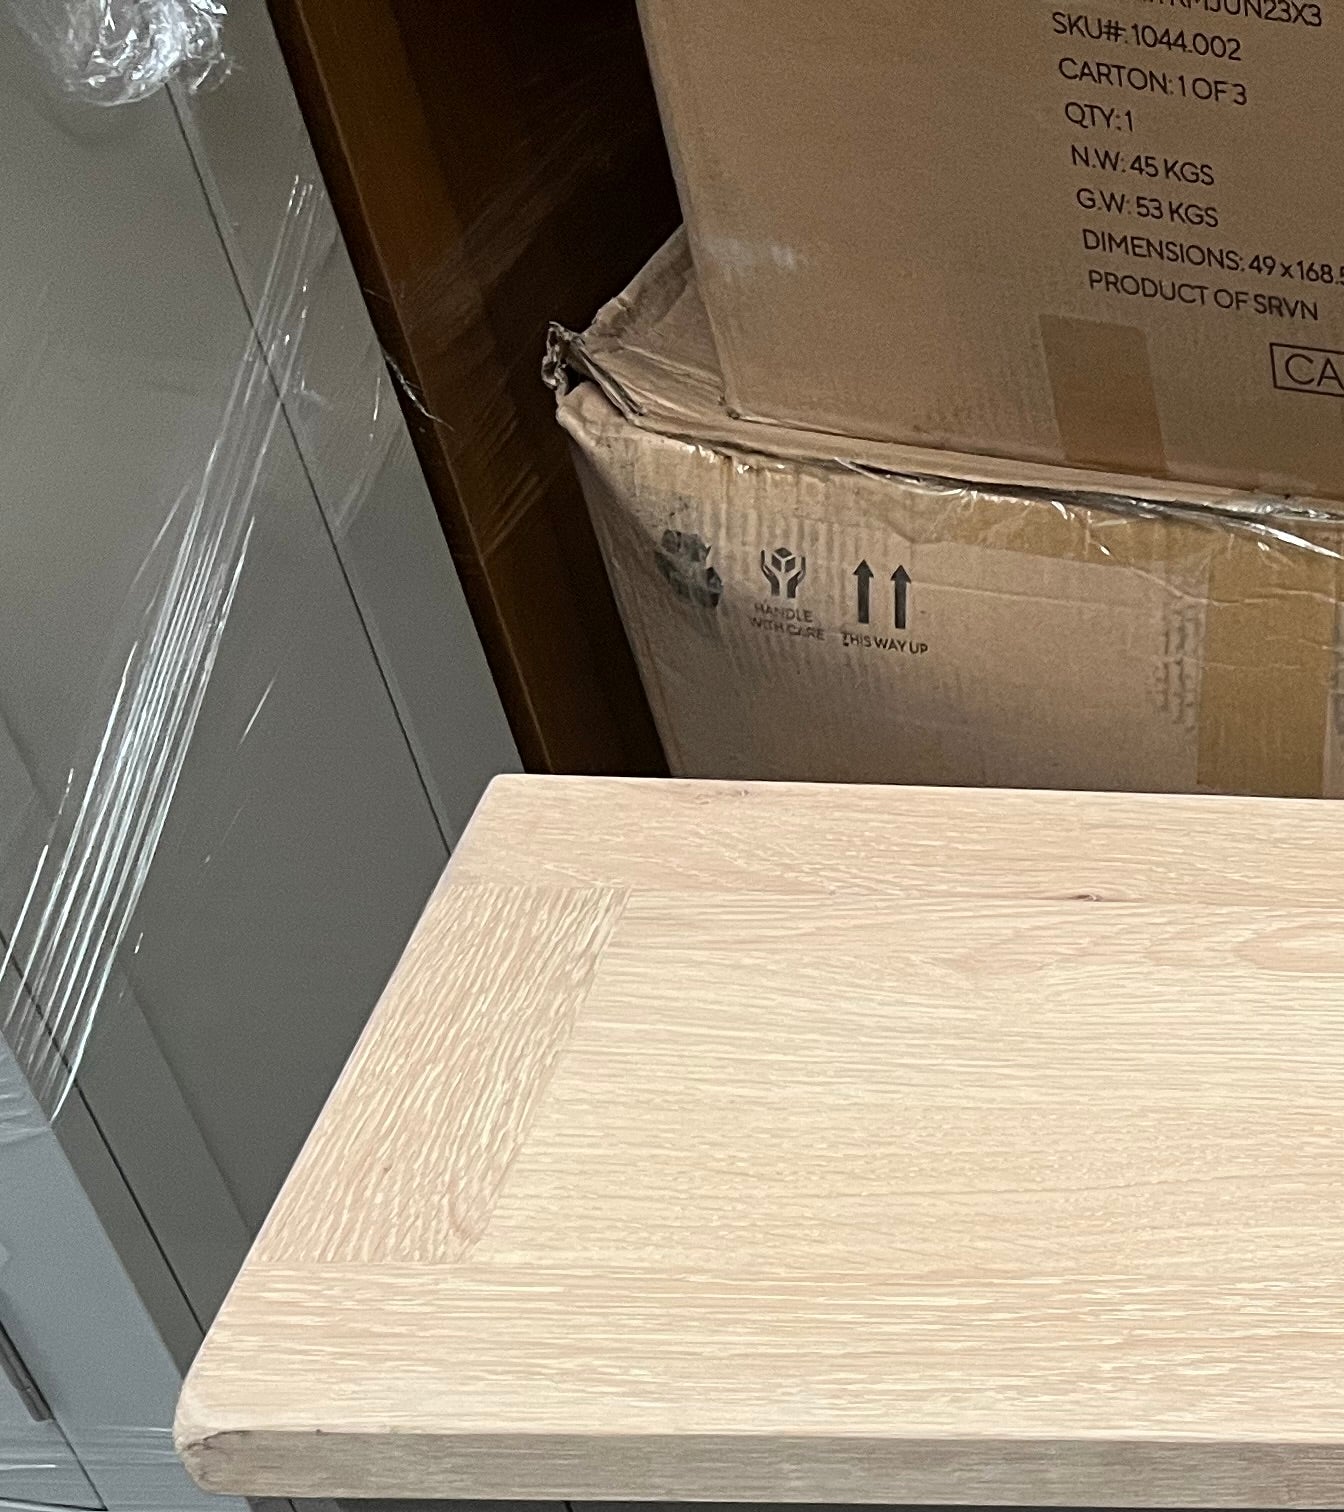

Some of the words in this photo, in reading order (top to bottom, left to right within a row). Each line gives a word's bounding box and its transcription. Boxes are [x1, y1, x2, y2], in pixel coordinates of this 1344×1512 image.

[1129, 155, 1159, 177] 45
[1164, 158, 1215, 186] KGS
[1136, 196, 1164, 219] 53
[1169, 201, 1219, 228] KGS
[1248, 255, 1277, 277] 49
[1088, 269, 1209, 306] PRODUCT
[1213, 289, 1252, 311] OF
[1254, 293, 1319, 322] SRVN
[754, 603, 814, 623] HANDLE
[873, 636, 907, 653] WAY
[908, 642, 929, 655] UP
